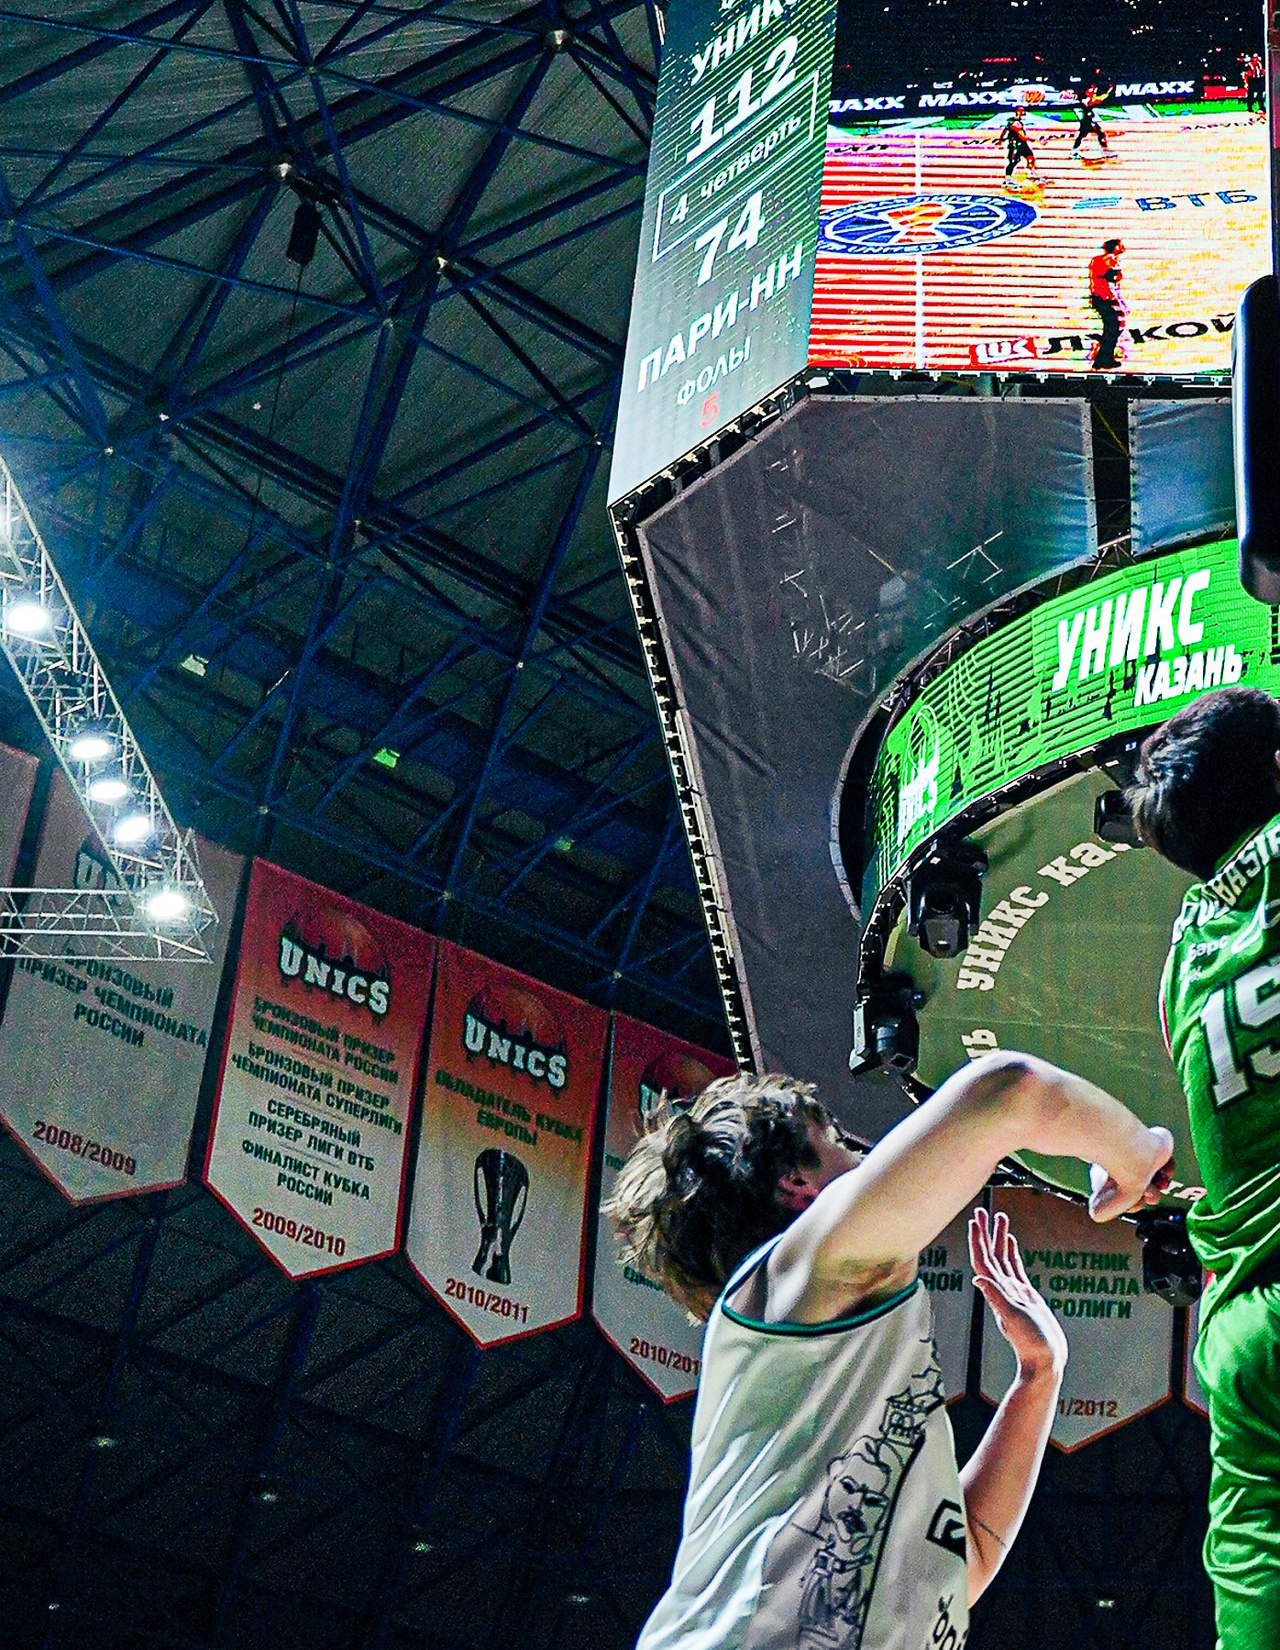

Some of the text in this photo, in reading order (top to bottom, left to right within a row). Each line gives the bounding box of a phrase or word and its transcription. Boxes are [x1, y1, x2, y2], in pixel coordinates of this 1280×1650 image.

[686, 36, 798, 164] 112
[918, 90, 1006, 107] MAXX
[1115, 80, 1195, 97] MAXX
[669, 192, 690, 225] 4
[1136, 189, 1258, 212] ВТБ
[694, 189, 766, 288] 74
[637, 241, 804, 394] ПАРИ-НН
[676, 336, 752, 406] ФОЛЫ
[700, 391, 720, 428] 5
[1052, 568, 1211, 692] УНИКС
[1133, 645, 1243, 707] КАЗАНЬ
[279, 937, 391, 1016] UNICS
[463, 1012, 569, 1089] UNICS
[33, 1120, 137, 1176] 2008/2009
[248, 1111, 376, 1172] ПРИЗЕР ЛИГИ ВТБ
[266, 1098, 362, 1148] СЕРЕБРЯНЫЙ
[241, 1138, 371, 1200] ФИНАЛИСТ КУБКА
[276, 1171, 333, 1207] РОССИИ
[251, 1206, 346, 1258] 2009/2010
[444, 1277, 529, 1325] 2010/2011
[1049, 1274, 1141, 1296] ФИНАЛА
[1052, 1299, 1132, 1319] РОЛИГИ
[630, 1336, 701, 1377] 2010/201
